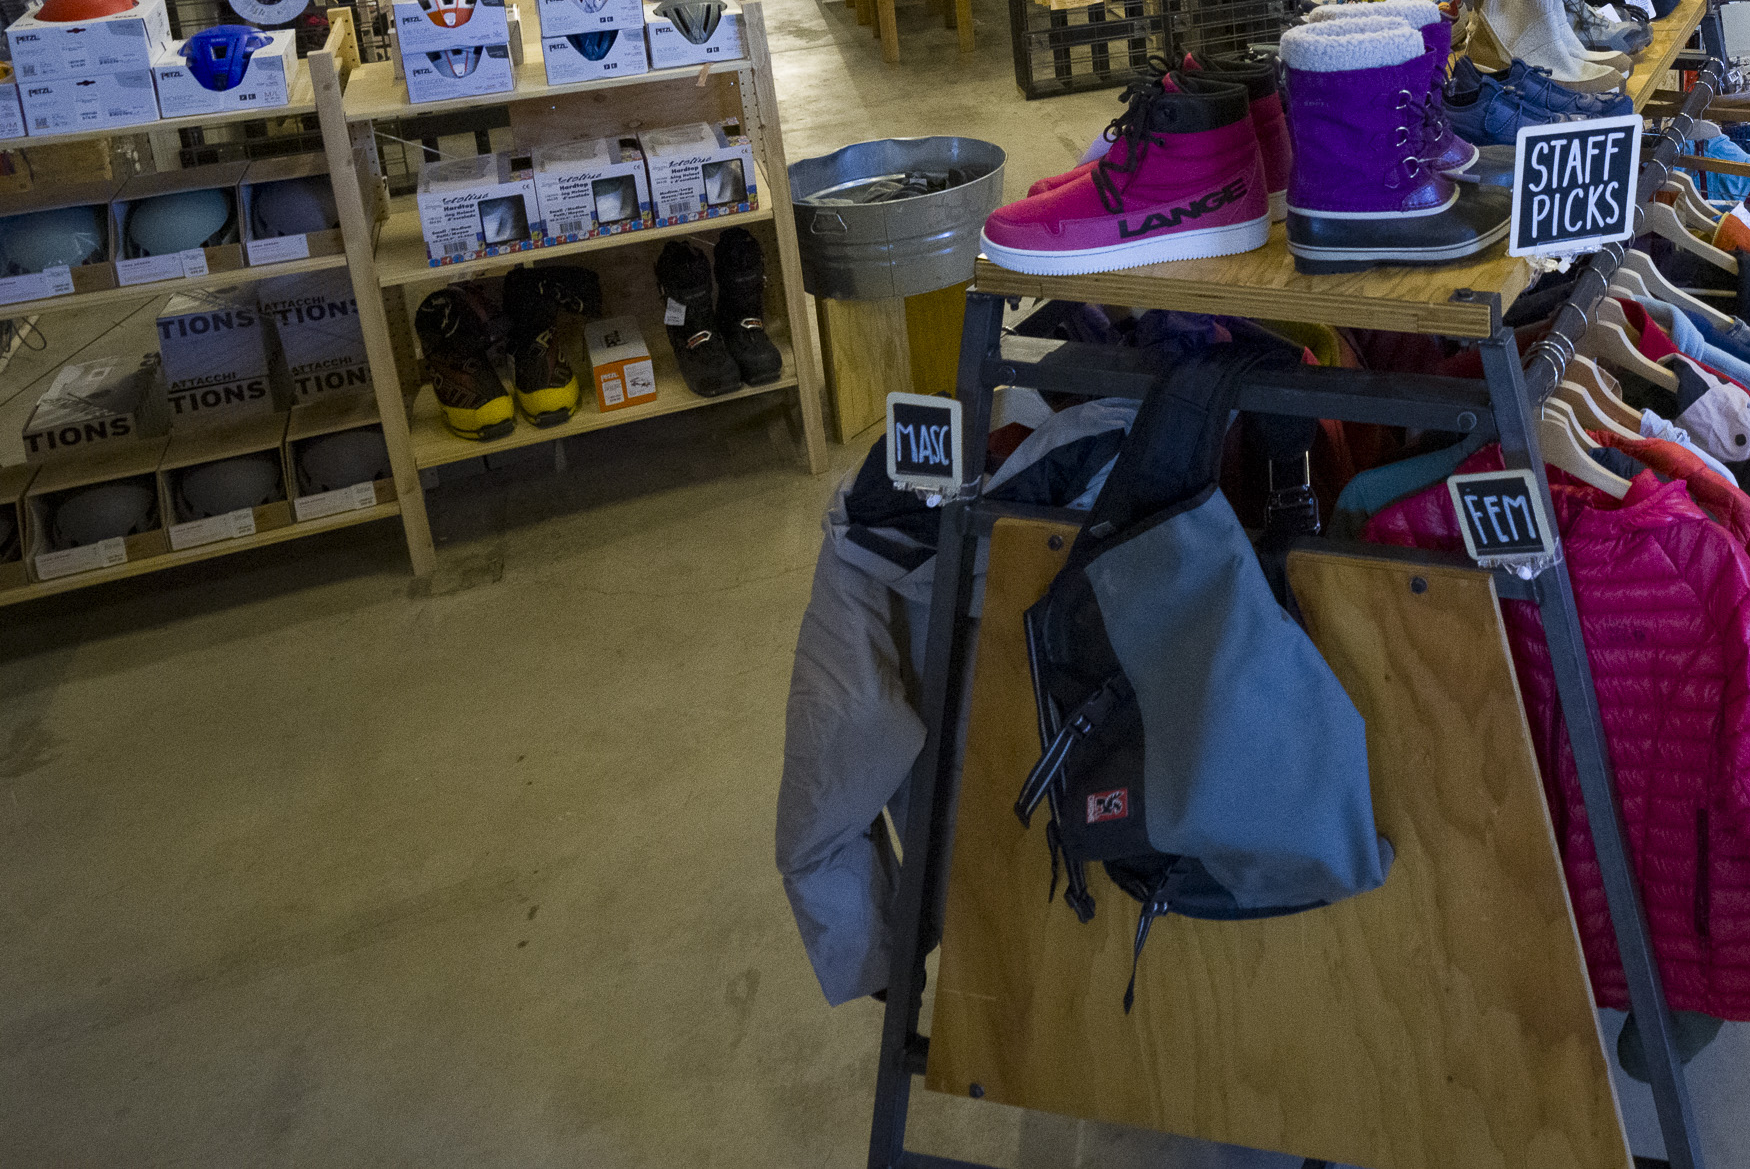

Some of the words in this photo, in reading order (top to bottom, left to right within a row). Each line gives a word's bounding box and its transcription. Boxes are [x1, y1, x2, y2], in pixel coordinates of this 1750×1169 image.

[671, 166, 699, 174] Hardtop
[1528, 132, 1627, 192] STAFF
[560, 183, 588, 191] Hardtop
[443, 203, 475, 212] Hardtop
[1118, 178, 1247, 239] LANGE
[1531, 182, 1621, 239] PICKS
[264, 295, 326, 313] ATTACCHI
[158, 309, 256, 340] TIONS
[171, 371, 237, 389] ATTACCHI
[292, 357, 353, 373] ATTACCHI
[167, 380, 267, 414] TIONS
[22, 416, 132, 453] TIONS
[894, 421, 952, 468] MASC
[1463, 493, 1537, 543] FEM
